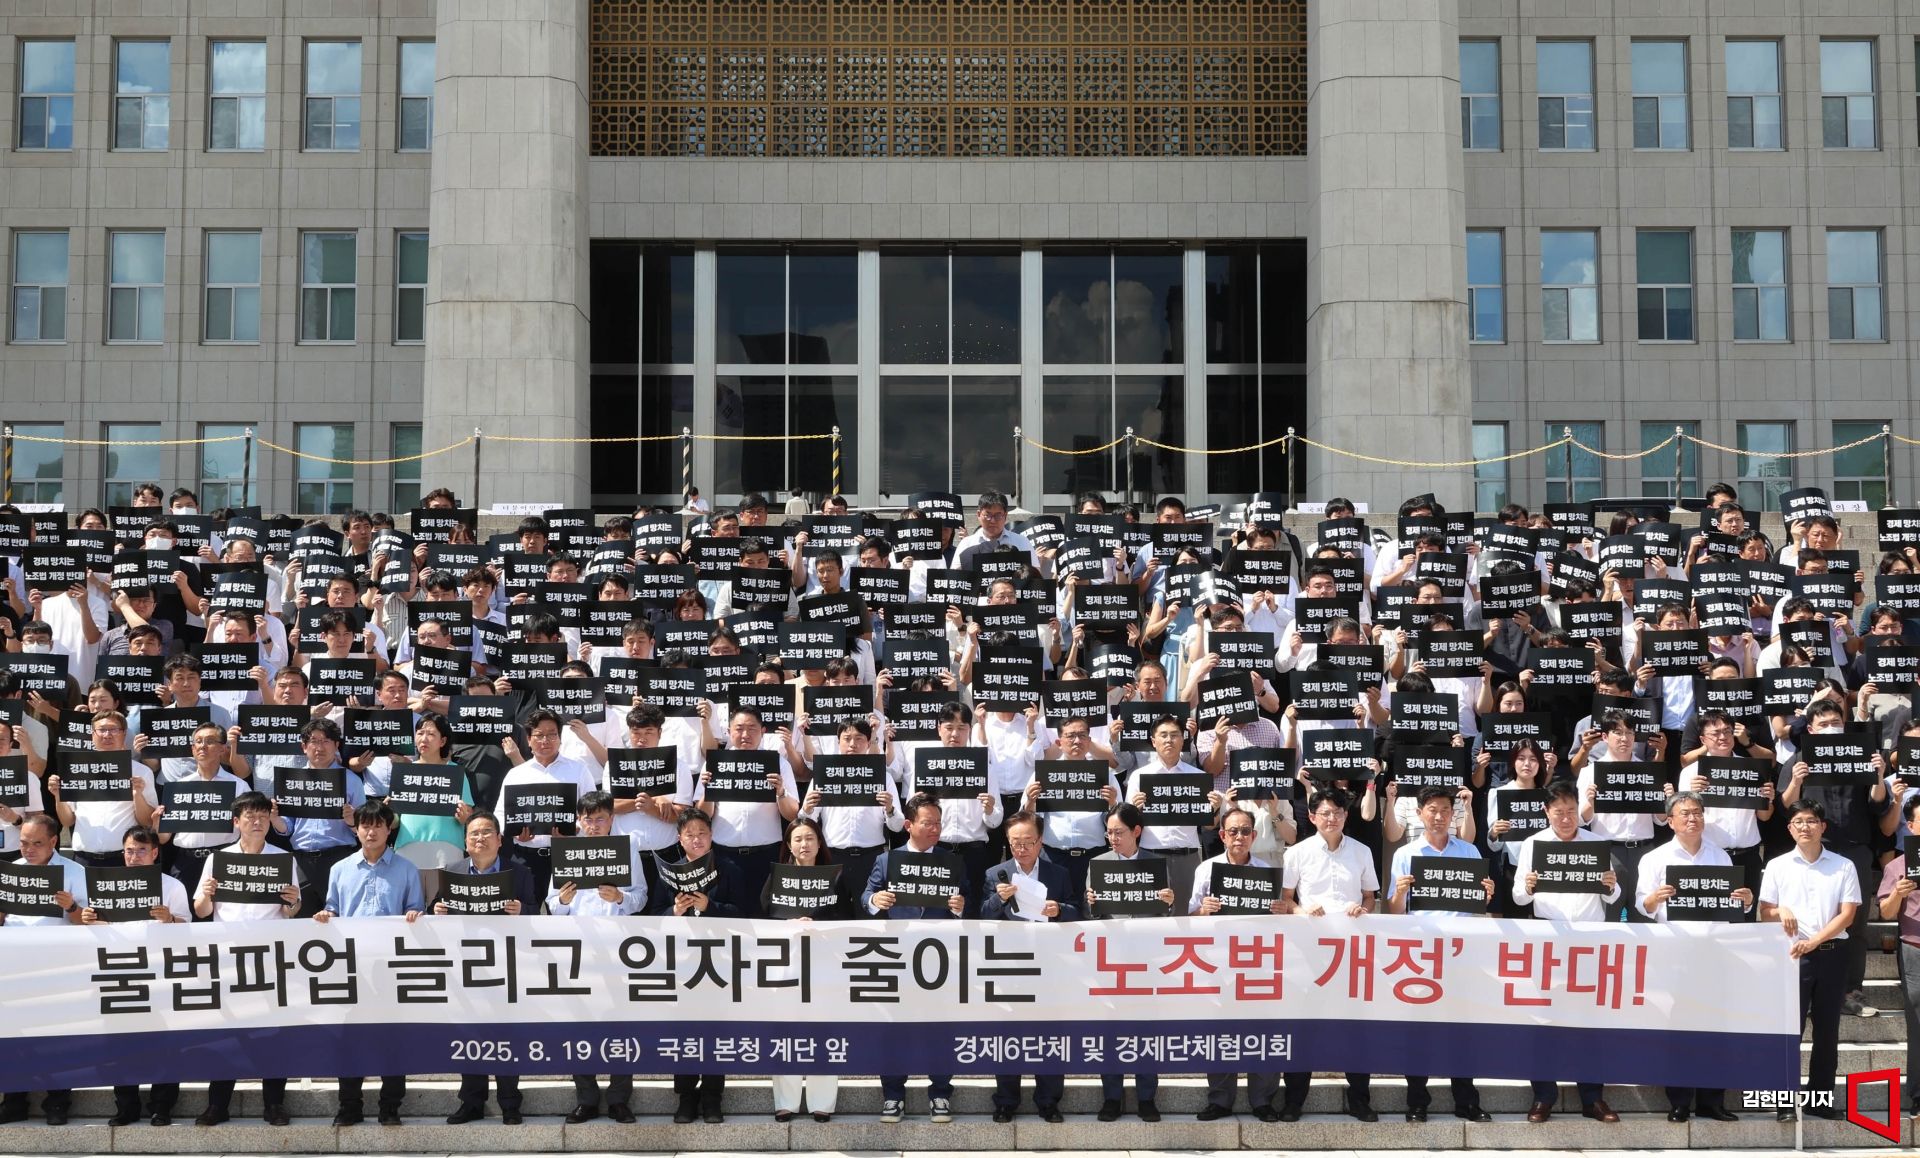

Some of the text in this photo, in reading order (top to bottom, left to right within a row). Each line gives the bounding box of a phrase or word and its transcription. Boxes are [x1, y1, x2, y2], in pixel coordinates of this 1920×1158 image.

[33, 557, 74, 566] 경제 망치는
[25, 572, 46, 580] 노조법
[49, 571, 64, 580] 개정
[1085, 595, 1127, 605] 경제 망치는
[1076, 610, 1099, 619] 노조법
[1102, 610, 1117, 619] 개정
[789, 633, 833, 643] 경제 망치는
[779, 649, 803, 658] 노조법
[806, 648, 822, 658] 개정
[1539, 659, 1583, 668] 경제 망치는
[319, 669, 363, 679] 경제 망치는
[983, 674, 1029, 685] 경제 망치는
[1556, 674, 1573, 683] 개정
[310, 685, 332, 694] 노조법
[335, 685, 352, 695] 개정
[974, 690, 998, 700] 노조법
[1000, 691, 1017, 701] 개정
[1814, 745, 1863, 756] 경제 망치는
[70, 763, 118, 773] 경제 망치는
[619, 759, 665, 771] 경제 망치는
[927, 759, 975, 770] 경제 망치는
[1239, 760, 1284, 771] 경제 망치는
[1406, 758, 1453, 769] 경제 망치는
[1833, 762, 1852, 773] 개정
[825, 766, 873, 777] 경제 망치는
[61, 779, 130, 790] 노조법 개정 반대!
[403, 774, 451, 787] 경제 망치는
[611, 774, 675, 787] 노조법 개정 반대!
[917, 776, 986, 787] 노조법 개정 반대!
[1231, 777, 1293, 787] 노조법 개정 반대!
[1395, 775, 1463, 786] 노조법 개정 반대!
[1606, 774, 1654, 784] 경제 망치는
[285, 779, 333, 791] 경제 망치는
[844, 783, 862, 794] 개정
[1152, 786, 1200, 796] 경제 망치는
[1596, 791, 1665, 801] 노조법 개정 반대!
[173, 793, 222, 804] 경제 망치는
[277, 795, 345, 807] 노조법 개정 반대!
[391, 791, 417, 801] 노조법
[419, 792, 438, 803] 개정
[516, 795, 564, 806] 경제 망치는
[1143, 803, 1212, 813] 노조법 개정 반대!
[190, 810, 209, 820] 개정
[211, 810, 232, 820] 반대!
[506, 812, 574, 823] 노조법 개정 반대!
[565, 848, 616, 860] 경제 망치는
[554, 865, 629, 877] 노조법 개정 반대!
[1423, 869, 1474, 882] 경제 망치는
[96, 879, 147, 891] 경제 망치는
[781, 877, 829, 890] 경제 망치는
[1679, 878, 1729, 889] 경제 망치는
[1411, 887, 1484, 900] 노조법 개정 반대!
[89, 897, 112, 909] 노조법
[115, 897, 135, 909] 개정
[772, 893, 837, 908] 노조법 개정 반대!
[1668, 897, 1695, 907] 노조법
[1698, 896, 1717, 908] 개정
[92, 939, 357, 1014] 불법파업
[388, 936, 591, 1003] 늘리고
[619, 936, 810, 1002] 일자리
[842, 936, 1041, 1003] 줄이는
[1499, 943, 1647, 1009] 반대!
[450, 1040, 519, 1062] 2025.
[528, 1040, 551, 1062] 8.
[656, 1037, 704, 1062] 국회
[713, 1037, 760, 1063] 본청
[769, 1037, 818, 1063] 계단
[825, 1037, 849, 1063] 앞
[953, 1034, 1292, 1064] 경제6단체 및 경제단체협의회
